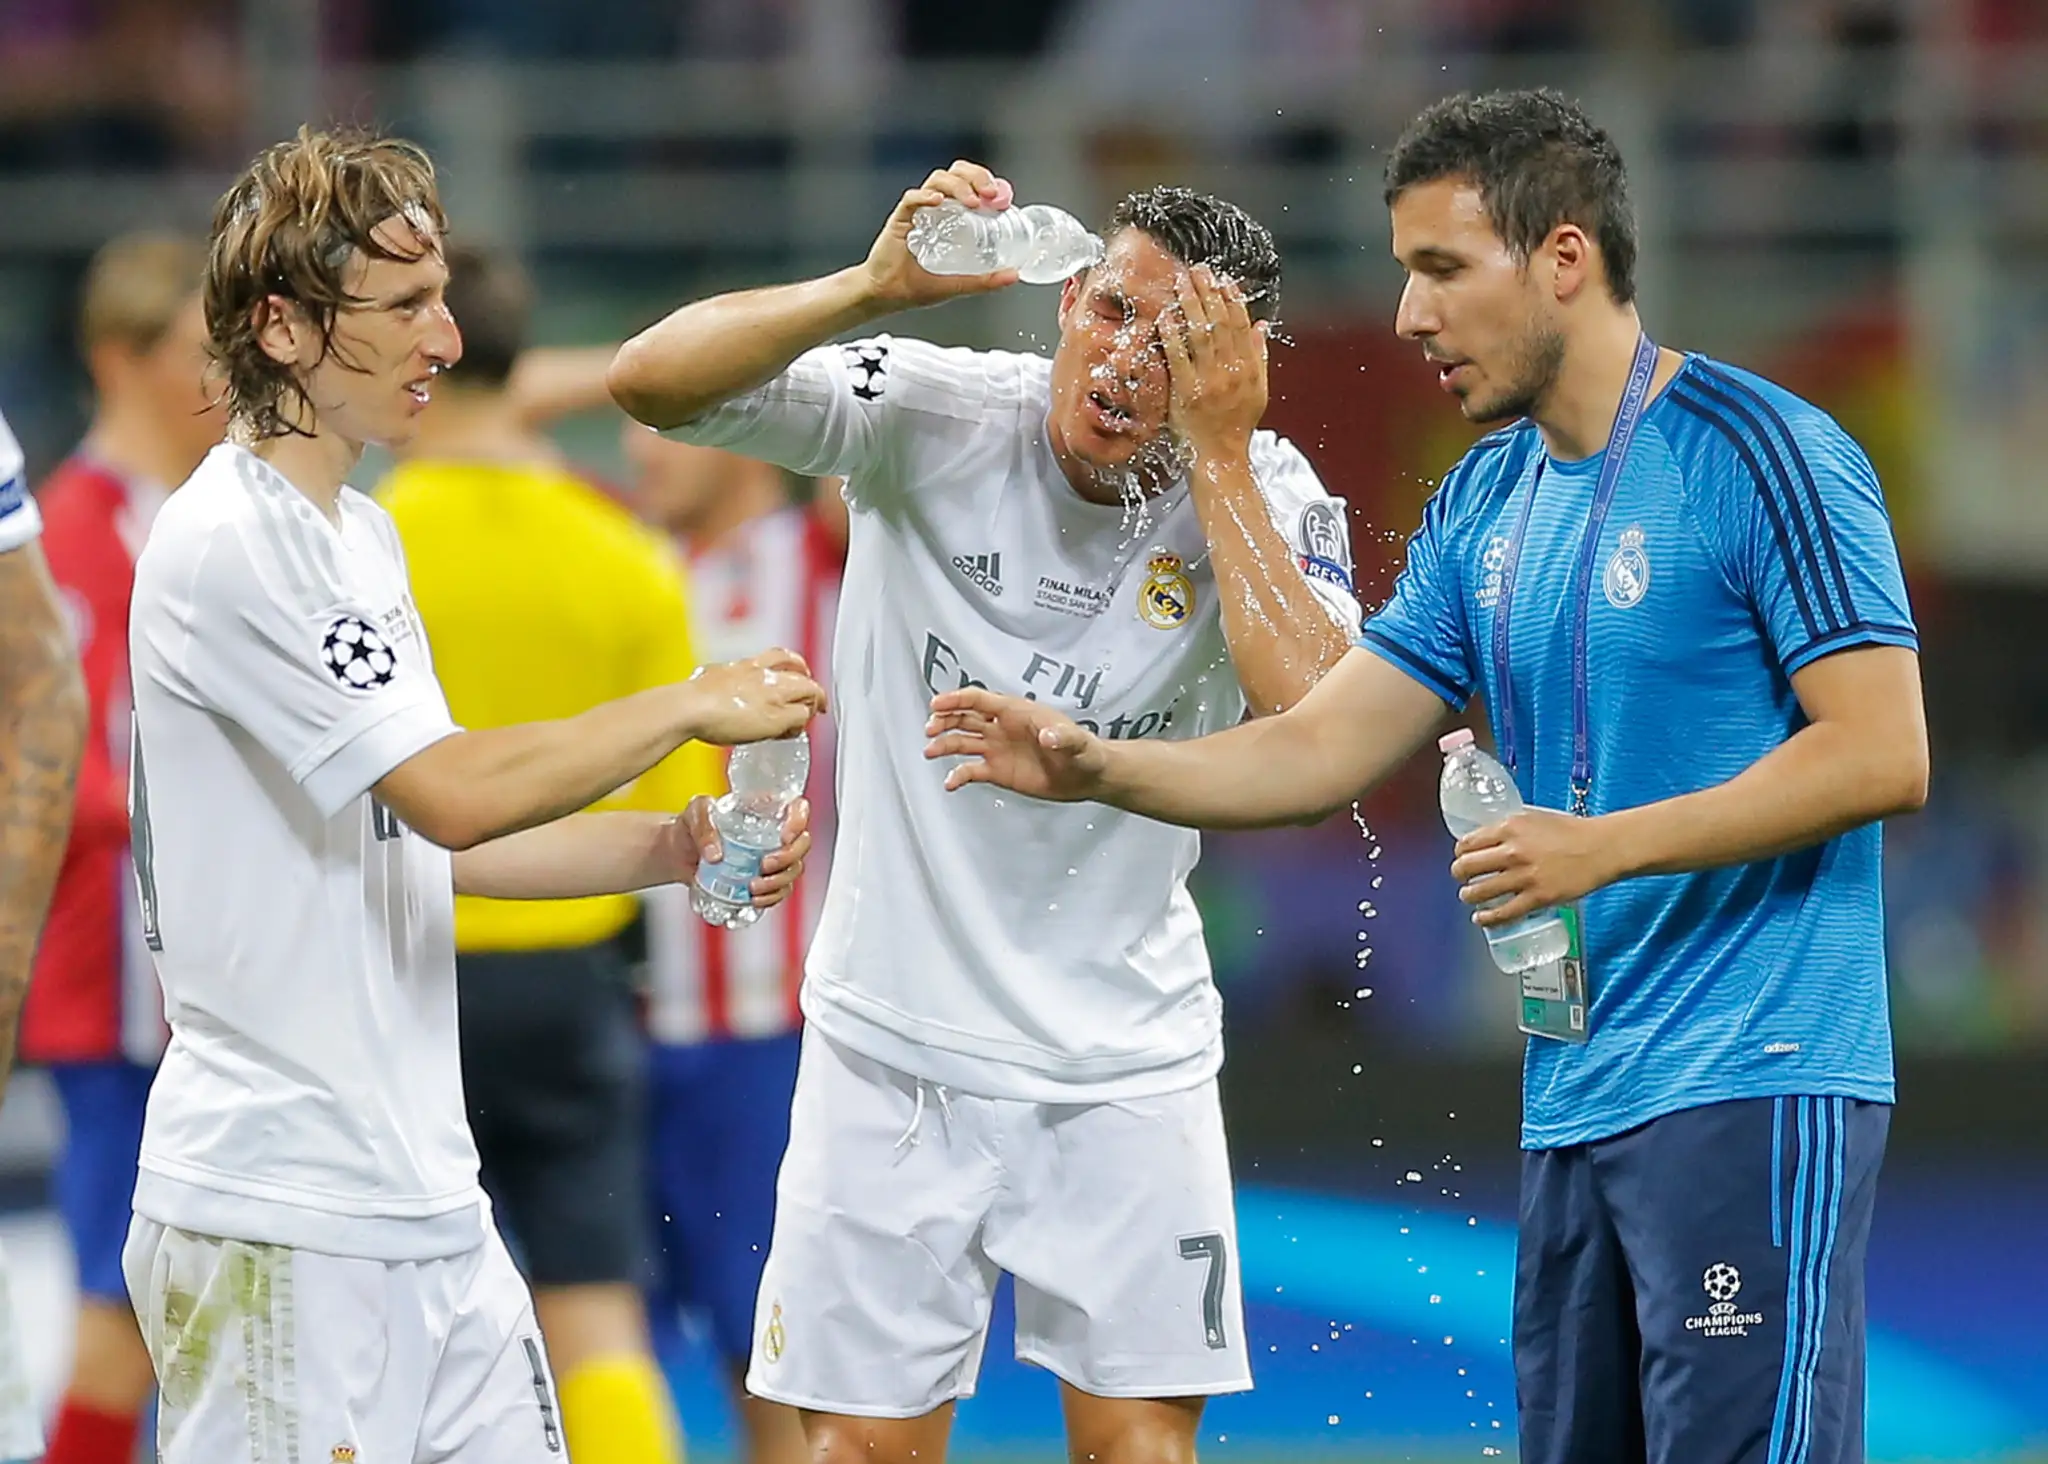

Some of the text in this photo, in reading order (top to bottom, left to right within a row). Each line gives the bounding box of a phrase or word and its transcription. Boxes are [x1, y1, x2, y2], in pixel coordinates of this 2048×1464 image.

[1611, 423, 1628, 459] FINAL
[1316, 536, 1337, 560] 10
[952, 556, 1003, 596] adidas
[1039, 577, 1071, 594] FINAL
[1022, 652, 1102, 710] Fly
[1178, 1232, 1227, 1350] 7
[1685, 1312, 1763, 1330] CHAMPIONS
